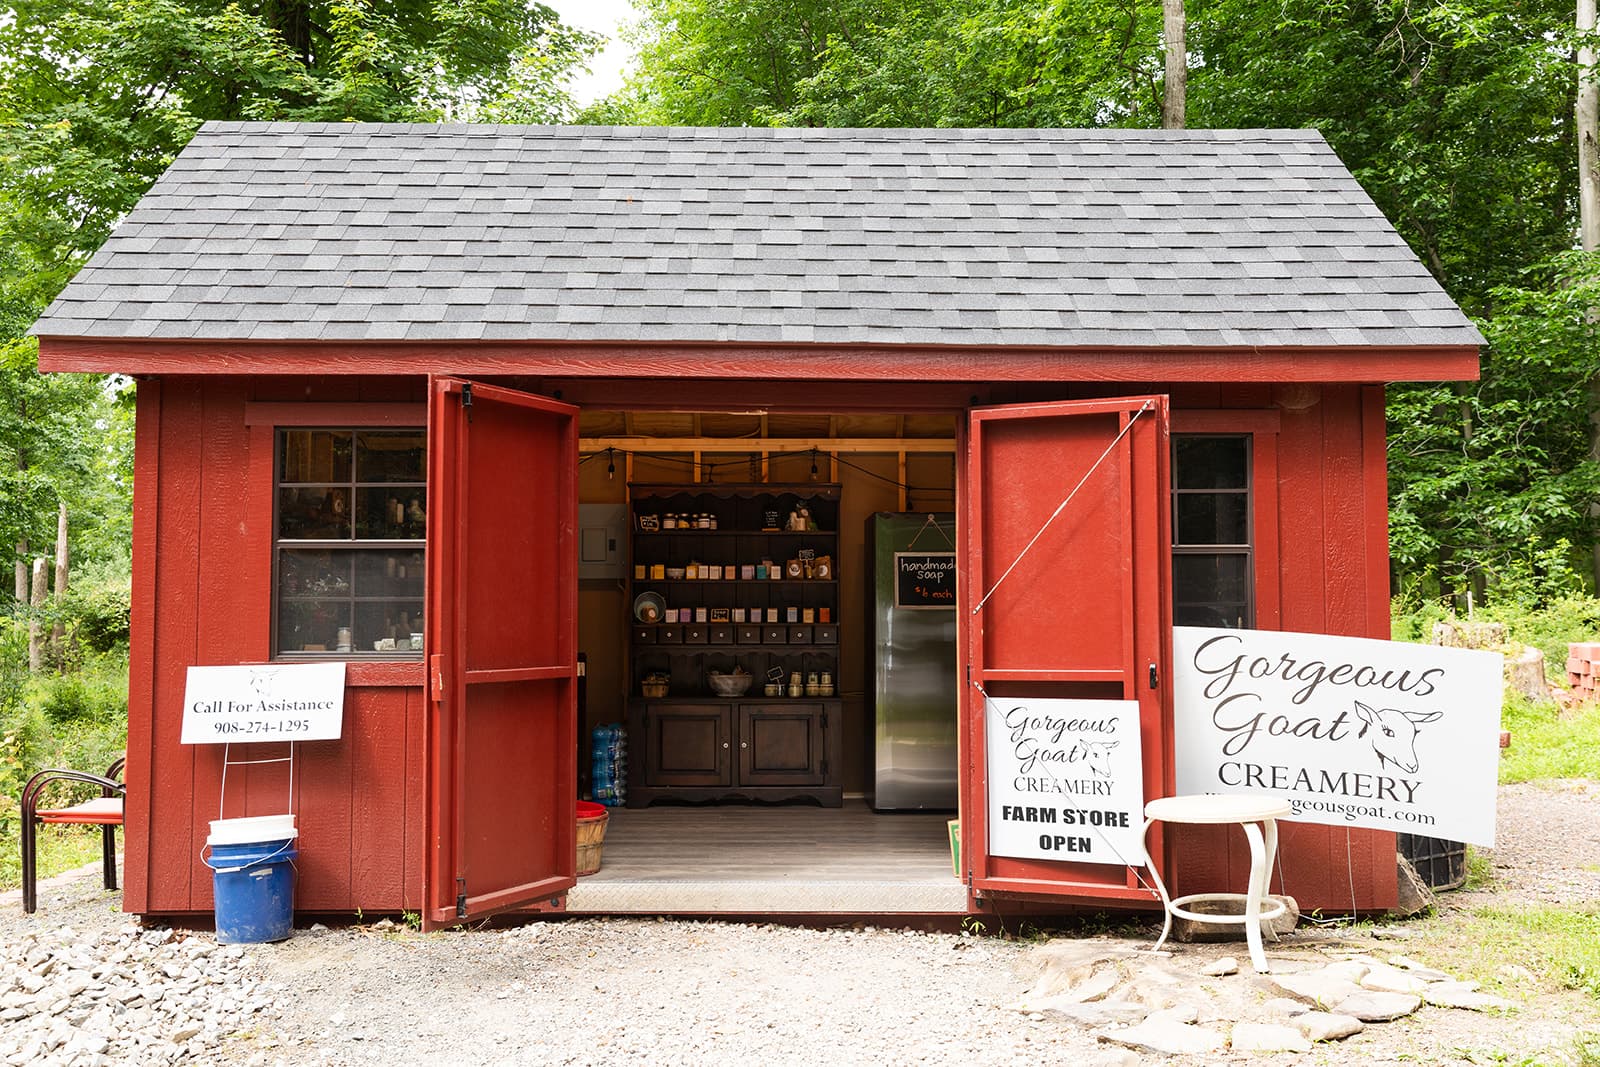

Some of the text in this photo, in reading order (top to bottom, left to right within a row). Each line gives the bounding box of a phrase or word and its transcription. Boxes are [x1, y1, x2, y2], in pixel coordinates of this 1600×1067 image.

[900, 557, 955, 572] handmad
[916, 570, 945, 584] soap
[932, 587, 953, 599] each
[1194, 635, 1445, 705] Gorgeous
[193, 699, 334, 714] Call For Assistance
[214, 720, 309, 734] 908-274-1295
[1005, 706, 1119, 744] Gorgeous
[1213, 694, 1350, 756] Goat
[1014, 738, 1078, 775] Goat
[1013, 776, 1115, 796] CREAMERY
[1218, 762, 1422, 804] CREAMERY
[1002, 805, 1130, 828] FARM STORE
[1039, 834, 1092, 853] OPEN
